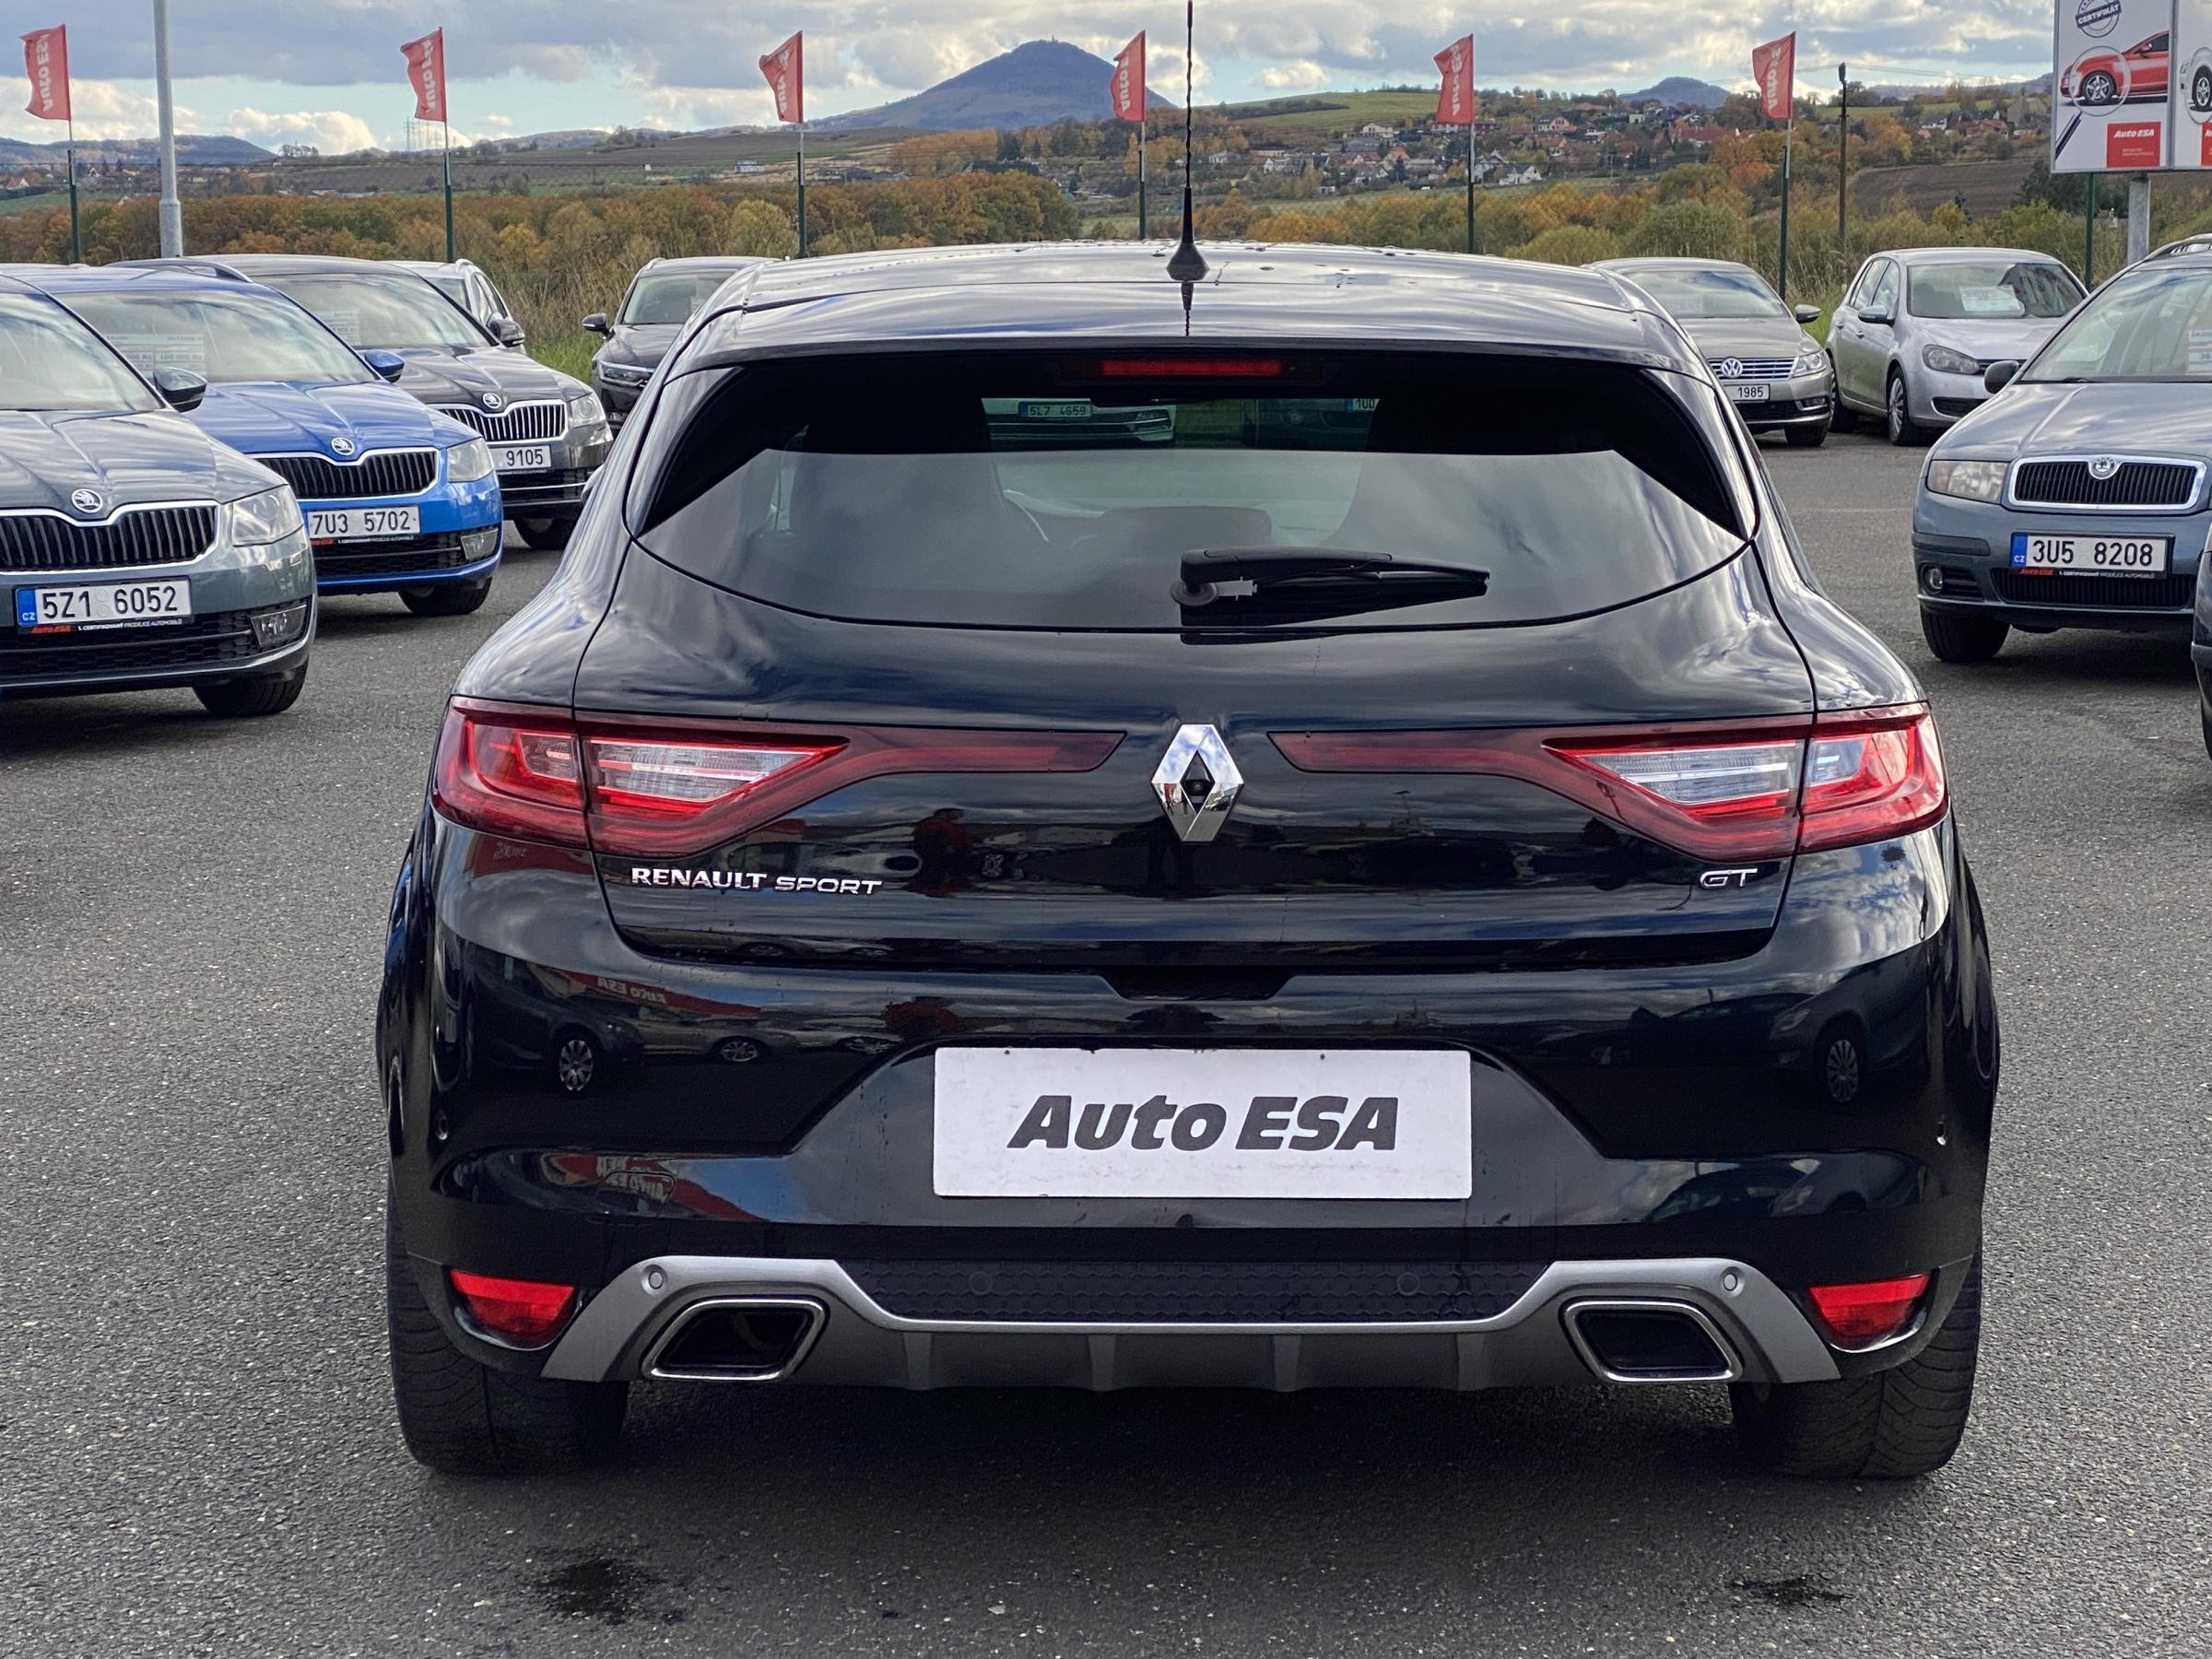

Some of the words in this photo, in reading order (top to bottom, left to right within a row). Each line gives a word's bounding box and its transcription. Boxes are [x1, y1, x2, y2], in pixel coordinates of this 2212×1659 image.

[2077, 4, 2120, 25] CERTIFIKÁT
[2113, 130, 2136, 138] Auto
[2137, 129, 2155, 137] ESA
[1737, 387, 1764, 398] 1985
[506, 448, 544, 467] 9105
[312, 513, 348, 535] 7U3
[363, 510, 411, 532] 5702
[2032, 540, 2076, 564] 3U5
[2094, 542, 2153, 567] 8208
[42, 591, 91, 619] 5Z1
[113, 585, 178, 615] 6052
[22, 612, 36, 621] CZ
[631, 867, 767, 889] RENAULT
[774, 876, 883, 895] SPORT
[1700, 868, 1758, 888] GT
[1006, 1095, 1227, 1151] Auto
[1235, 1096, 1399, 1151] ESA
